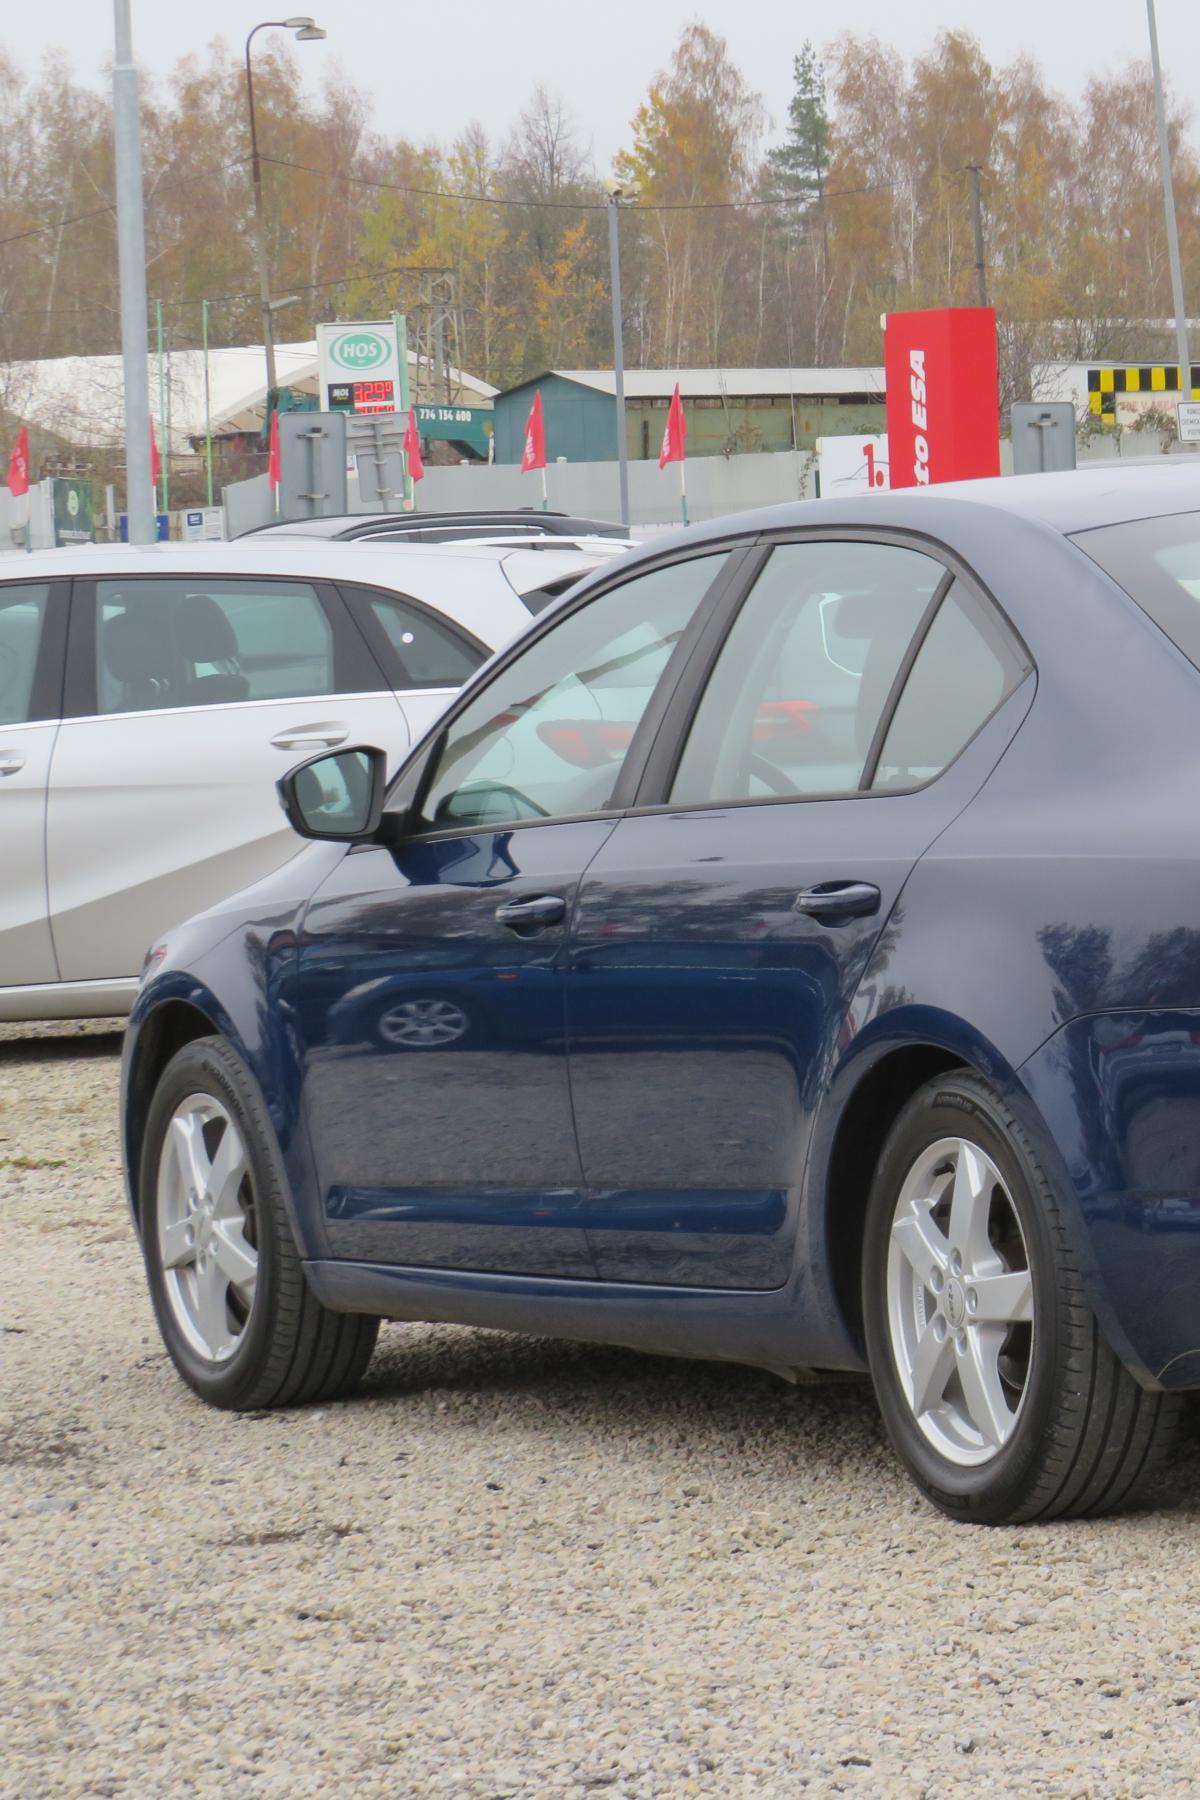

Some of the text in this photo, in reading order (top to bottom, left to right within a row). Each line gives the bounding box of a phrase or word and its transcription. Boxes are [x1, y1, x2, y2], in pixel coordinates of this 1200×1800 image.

[343, 342, 378, 358] HOS
[420, 408, 436, 420] 774
[456, 410, 472, 422] 600
[910, 350, 930, 487] to ESA
[863, 443, 885, 488] 1.
